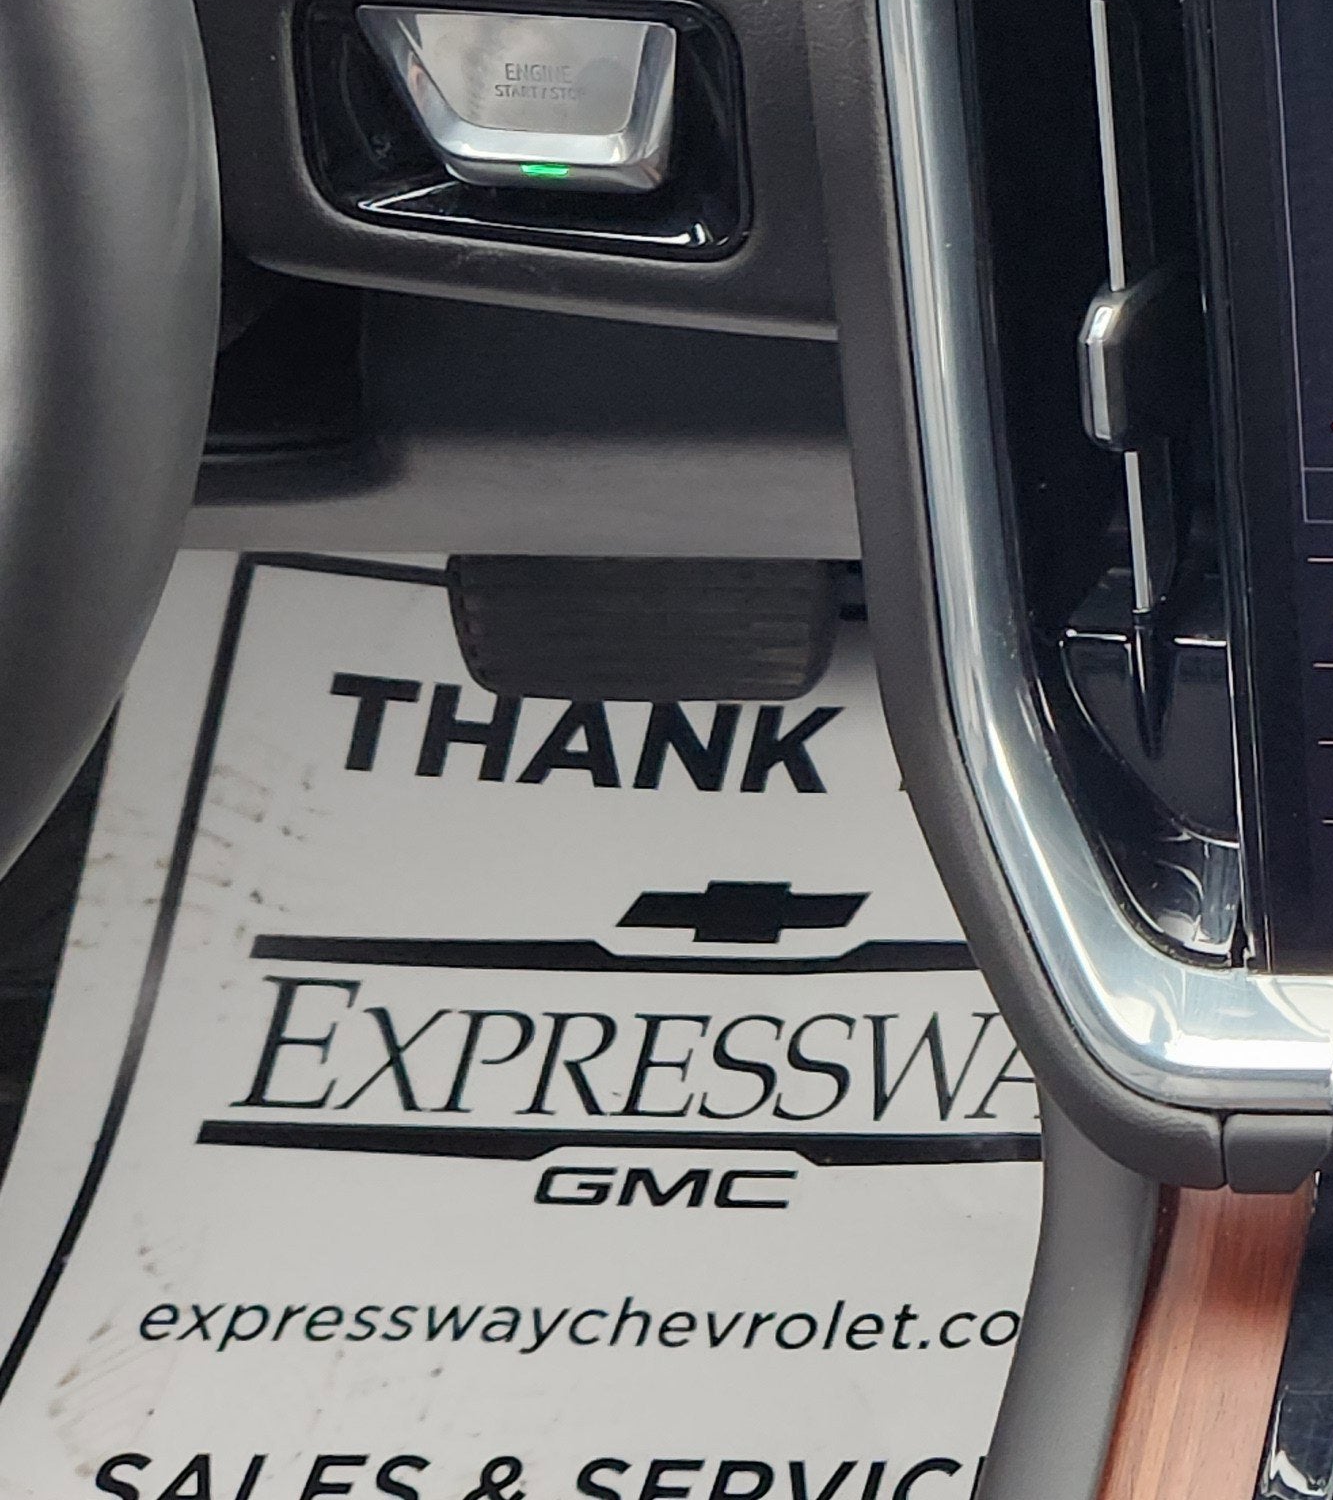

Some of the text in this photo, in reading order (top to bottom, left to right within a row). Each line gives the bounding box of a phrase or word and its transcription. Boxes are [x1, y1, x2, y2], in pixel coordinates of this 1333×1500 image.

[505, 63, 573, 83] ENGINE
[330, 672, 846, 794] THANK
[533, 1166, 798, 1210] GMC
[576, 1456, 987, 1500] SERVIC
